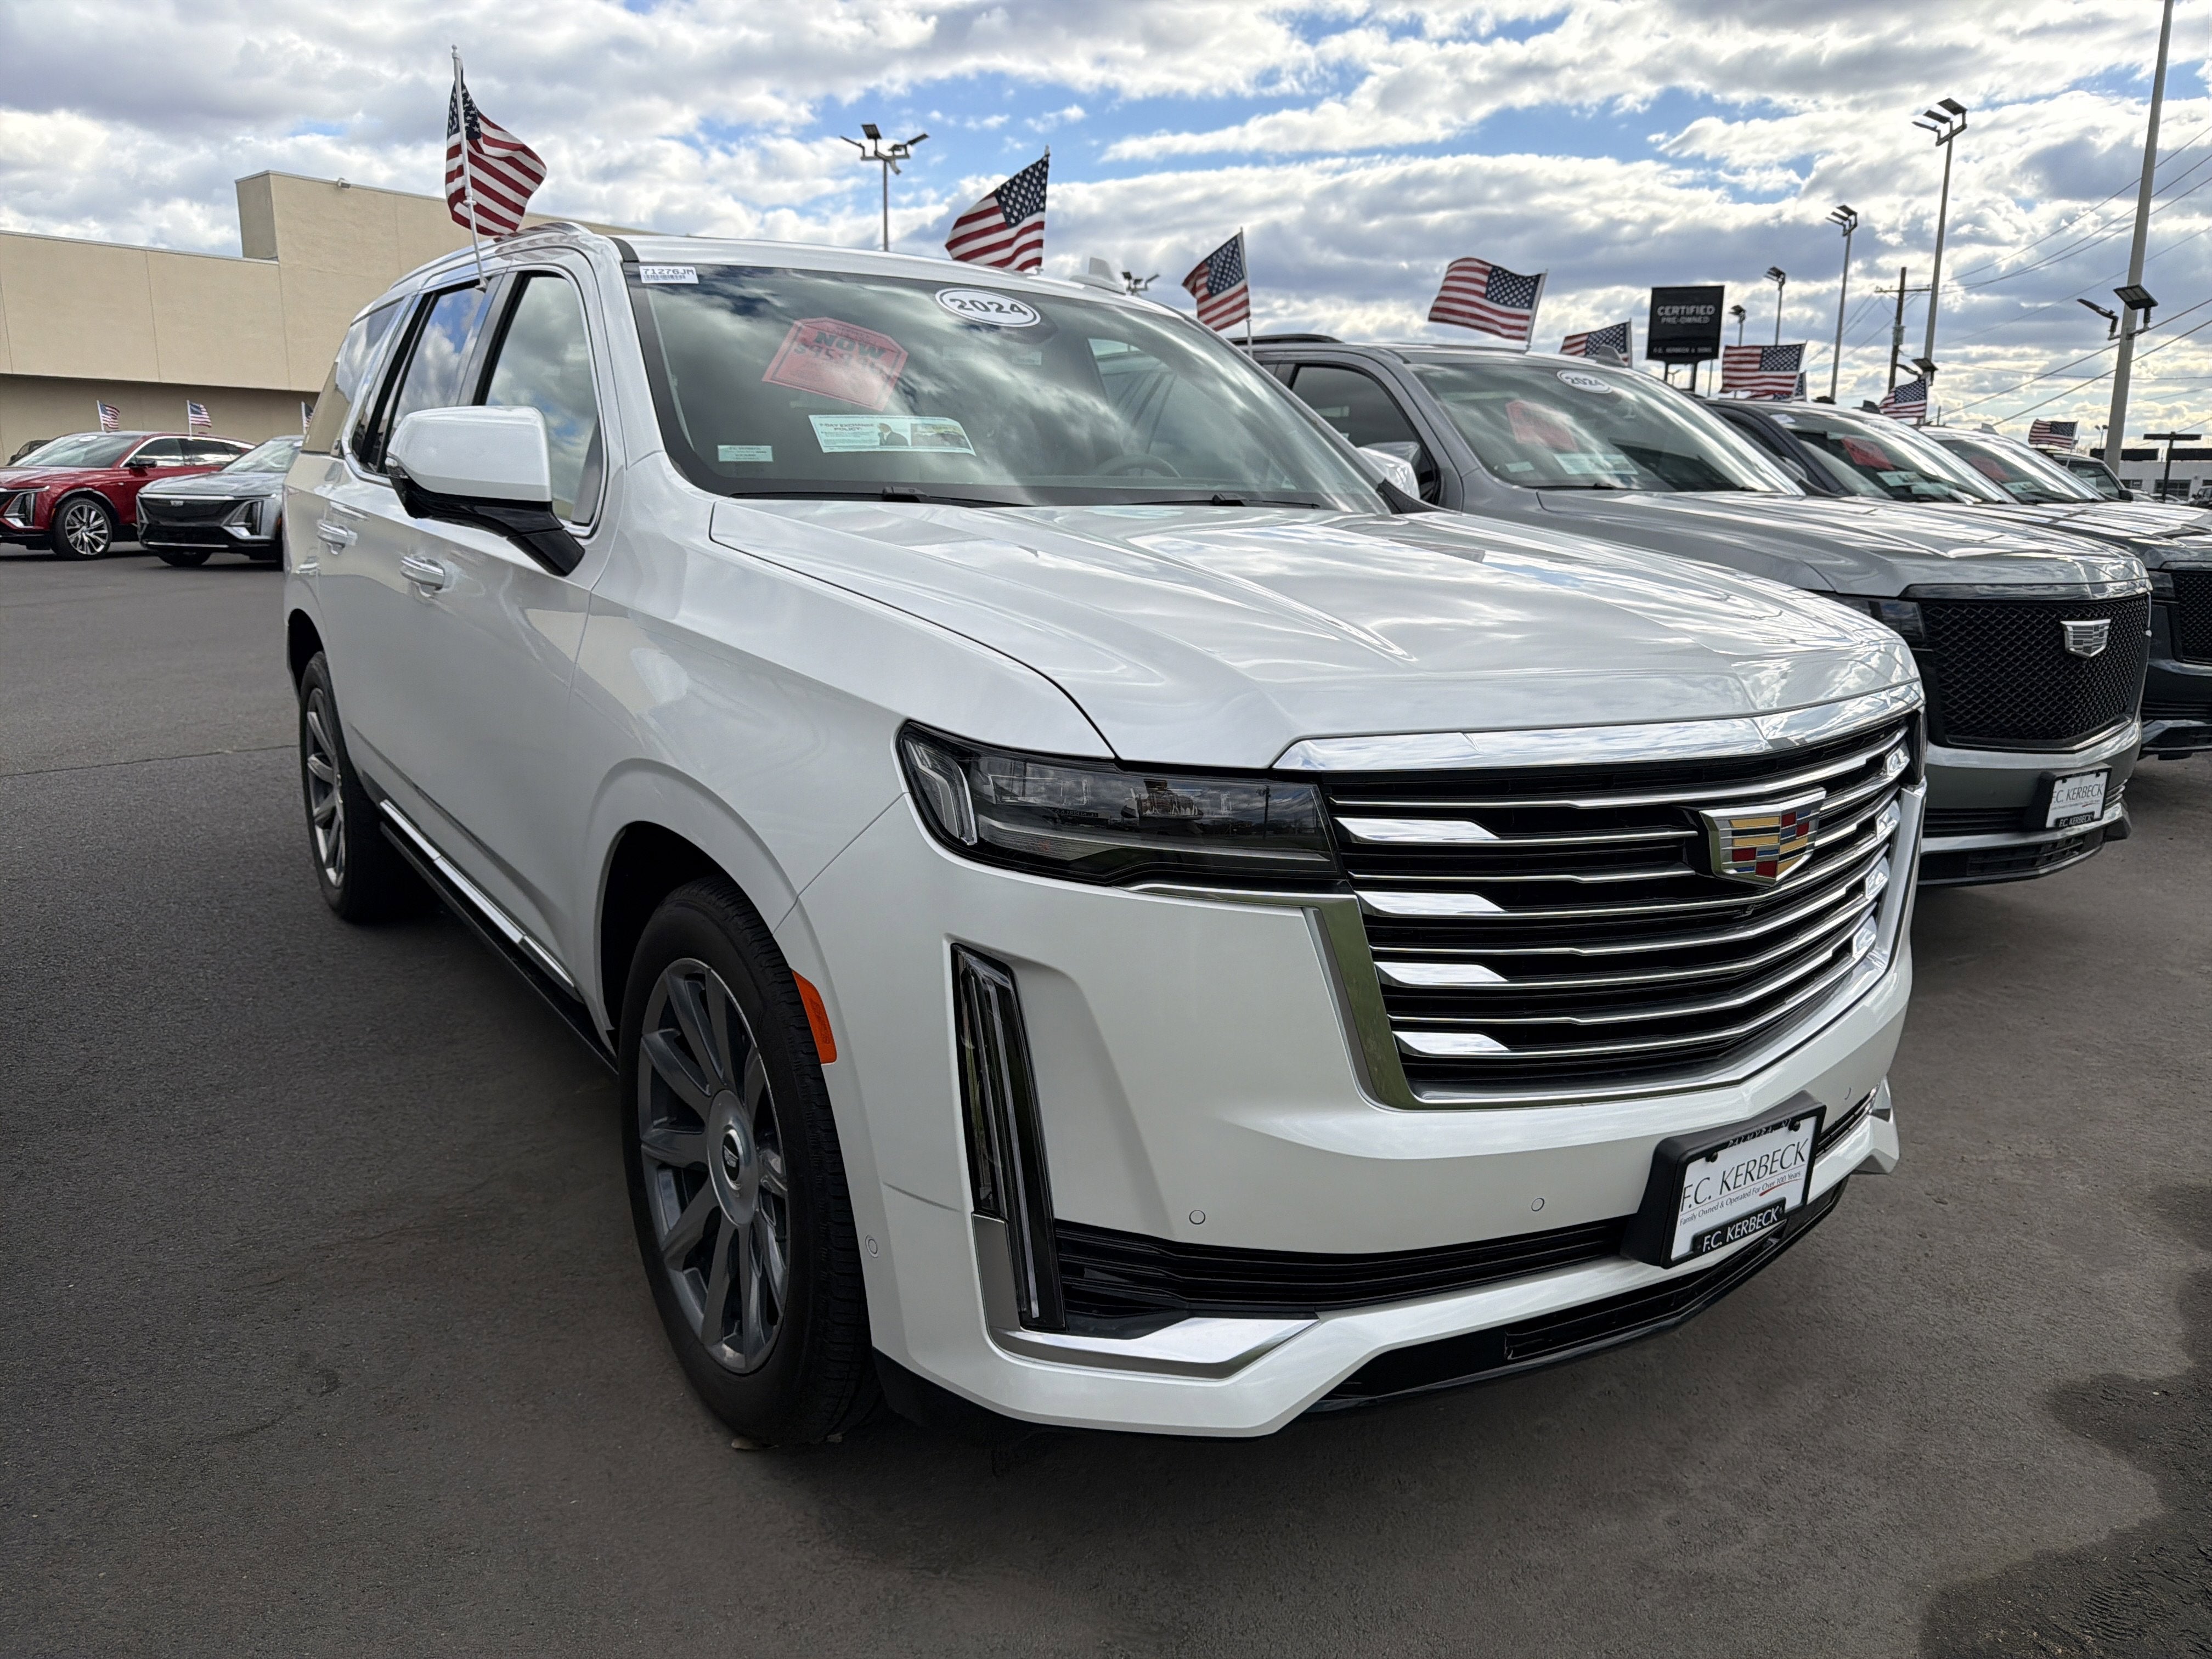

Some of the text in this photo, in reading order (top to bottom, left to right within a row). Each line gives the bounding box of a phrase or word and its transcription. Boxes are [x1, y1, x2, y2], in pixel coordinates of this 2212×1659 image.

[949, 298, 1029, 317] 2024
[1657, 304, 1716, 316] CERTIFIED
[1661, 316, 1711, 324] PRE-OWNED
[815, 331, 886, 359] NOW
[1565, 376, 1605, 387] 2024
[2066, 783, 2104, 801] KERBECK
[2068, 814, 2091, 825] KERBECK
[1680, 1138, 1809, 1212] F.C. KERBECK
[1680, 1212, 1697, 1227] Family
[1698, 1203, 1719, 1218] Owned
[1725, 1190, 1751, 1206] Operated
[1752, 1186, 1760, 1195] For
[1762, 1181, 1775, 1190] Over
[1776, 1176, 1786, 1185] 100
[1787, 1171, 1801, 1180] Years
[1702, 1205, 1780, 1252] F.C. KERBECK
